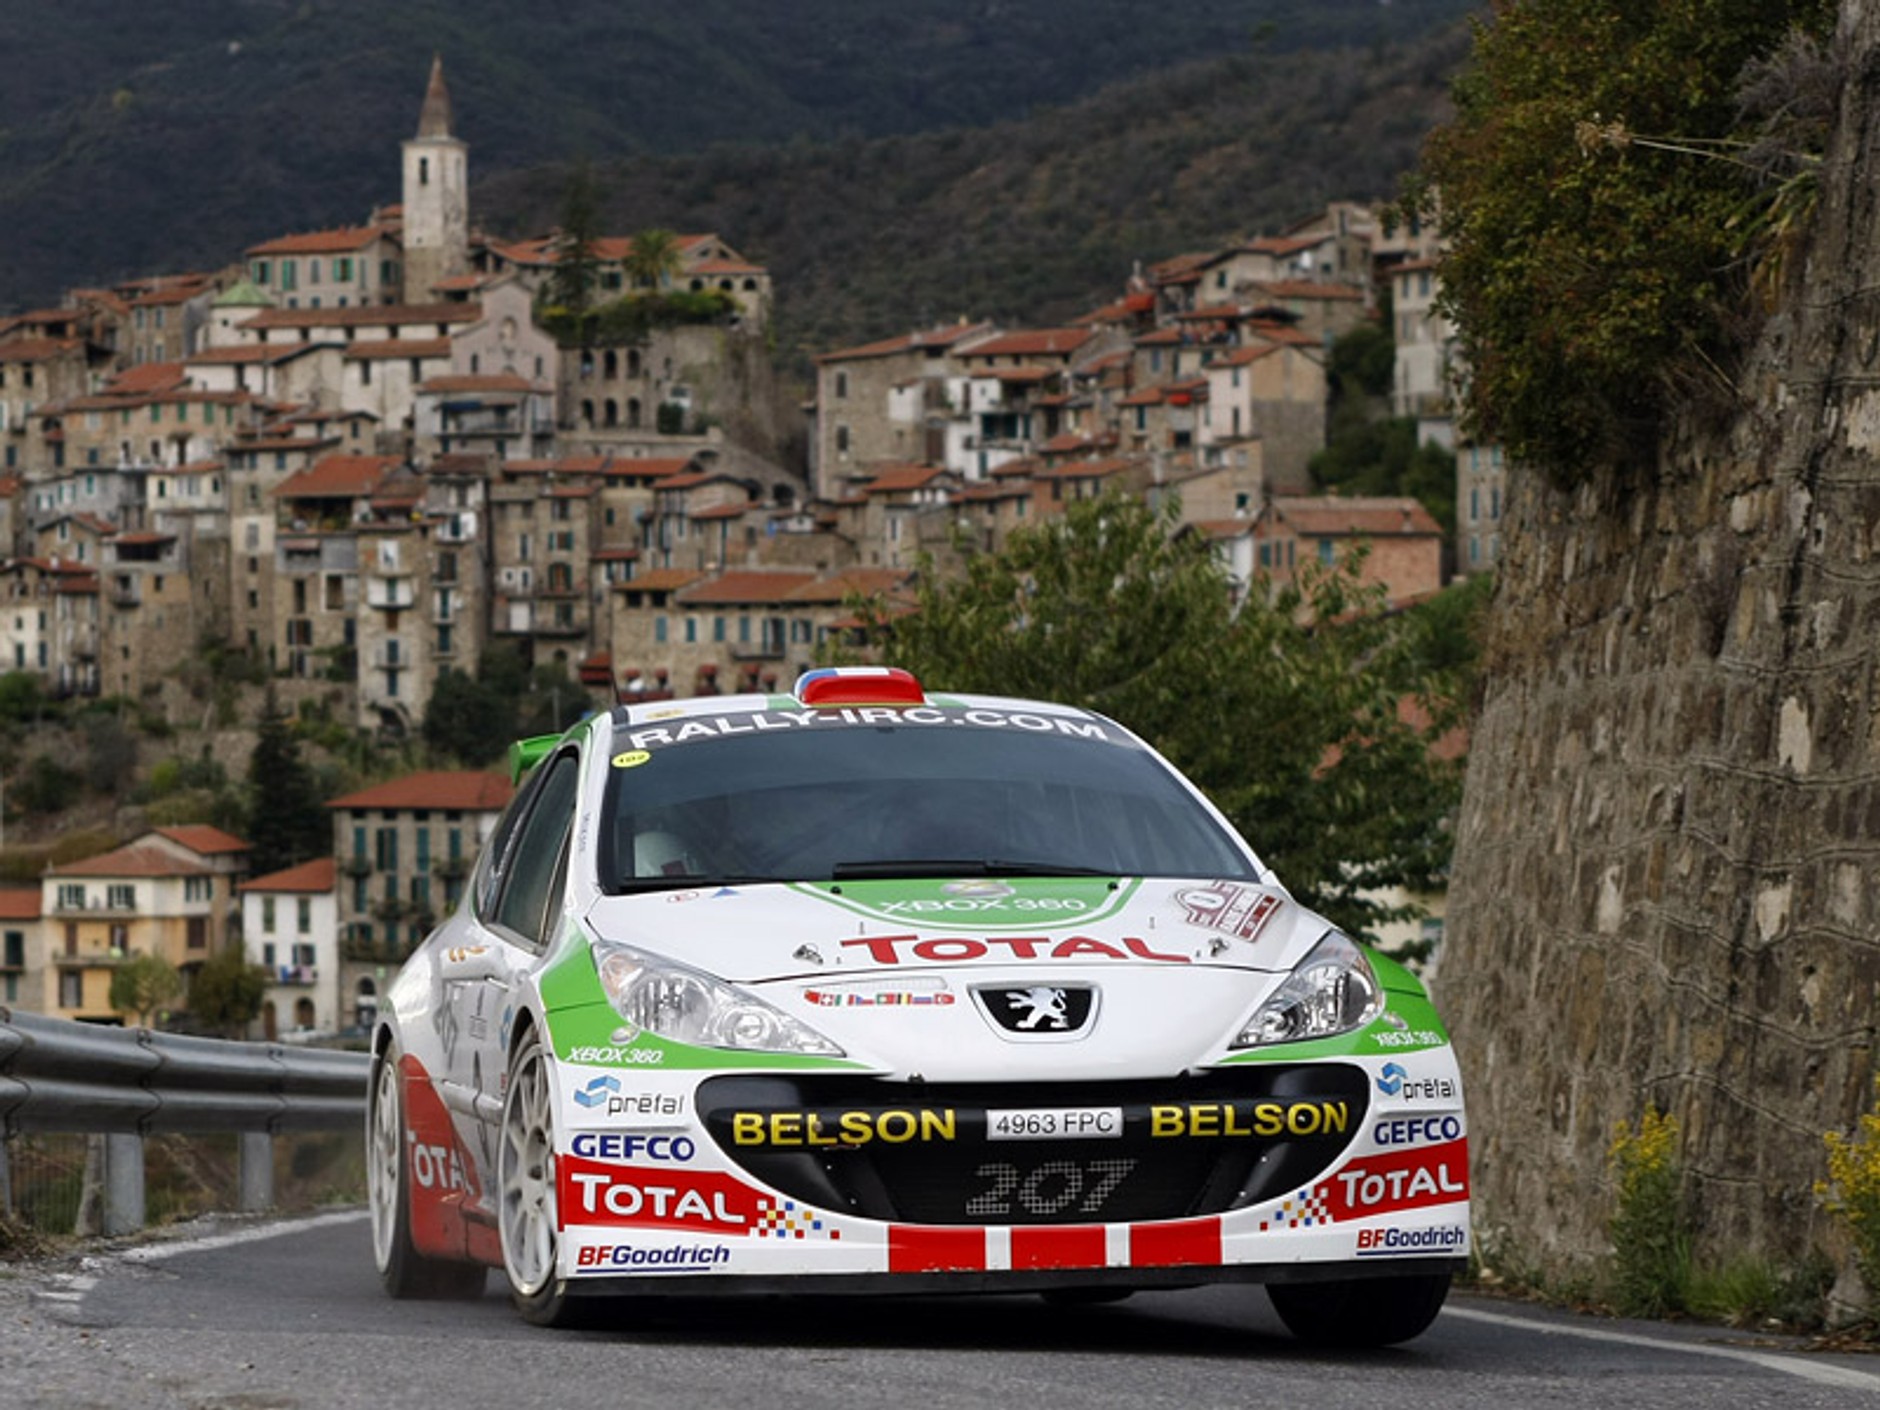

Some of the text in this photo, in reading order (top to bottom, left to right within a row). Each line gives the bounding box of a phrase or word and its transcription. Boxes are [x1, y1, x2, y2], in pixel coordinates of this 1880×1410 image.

[629, 707, 1109, 749] RALLY-IRC.COM
[880, 898, 1086, 913] XBOX 360
[840, 935, 1191, 965] TOTAL
[565, 1046, 663, 1064] XBOX 360
[733, 1108, 956, 1146] BELSON
[996, 1111, 1114, 1135] 4963 FPC
[1151, 1102, 1348, 1138] BELSON
[1374, 1116, 1461, 1146] GEFCO
[571, 1134, 695, 1161] GEFCO
[570, 1172, 746, 1224] TOTAL
[966, 1158, 1138, 1216] 207
[1337, 1163, 1465, 1208] TOTAL
[1356, 1226, 1465, 1250] BFGoodrich
[576, 1244, 730, 1266] BFGoodrich
